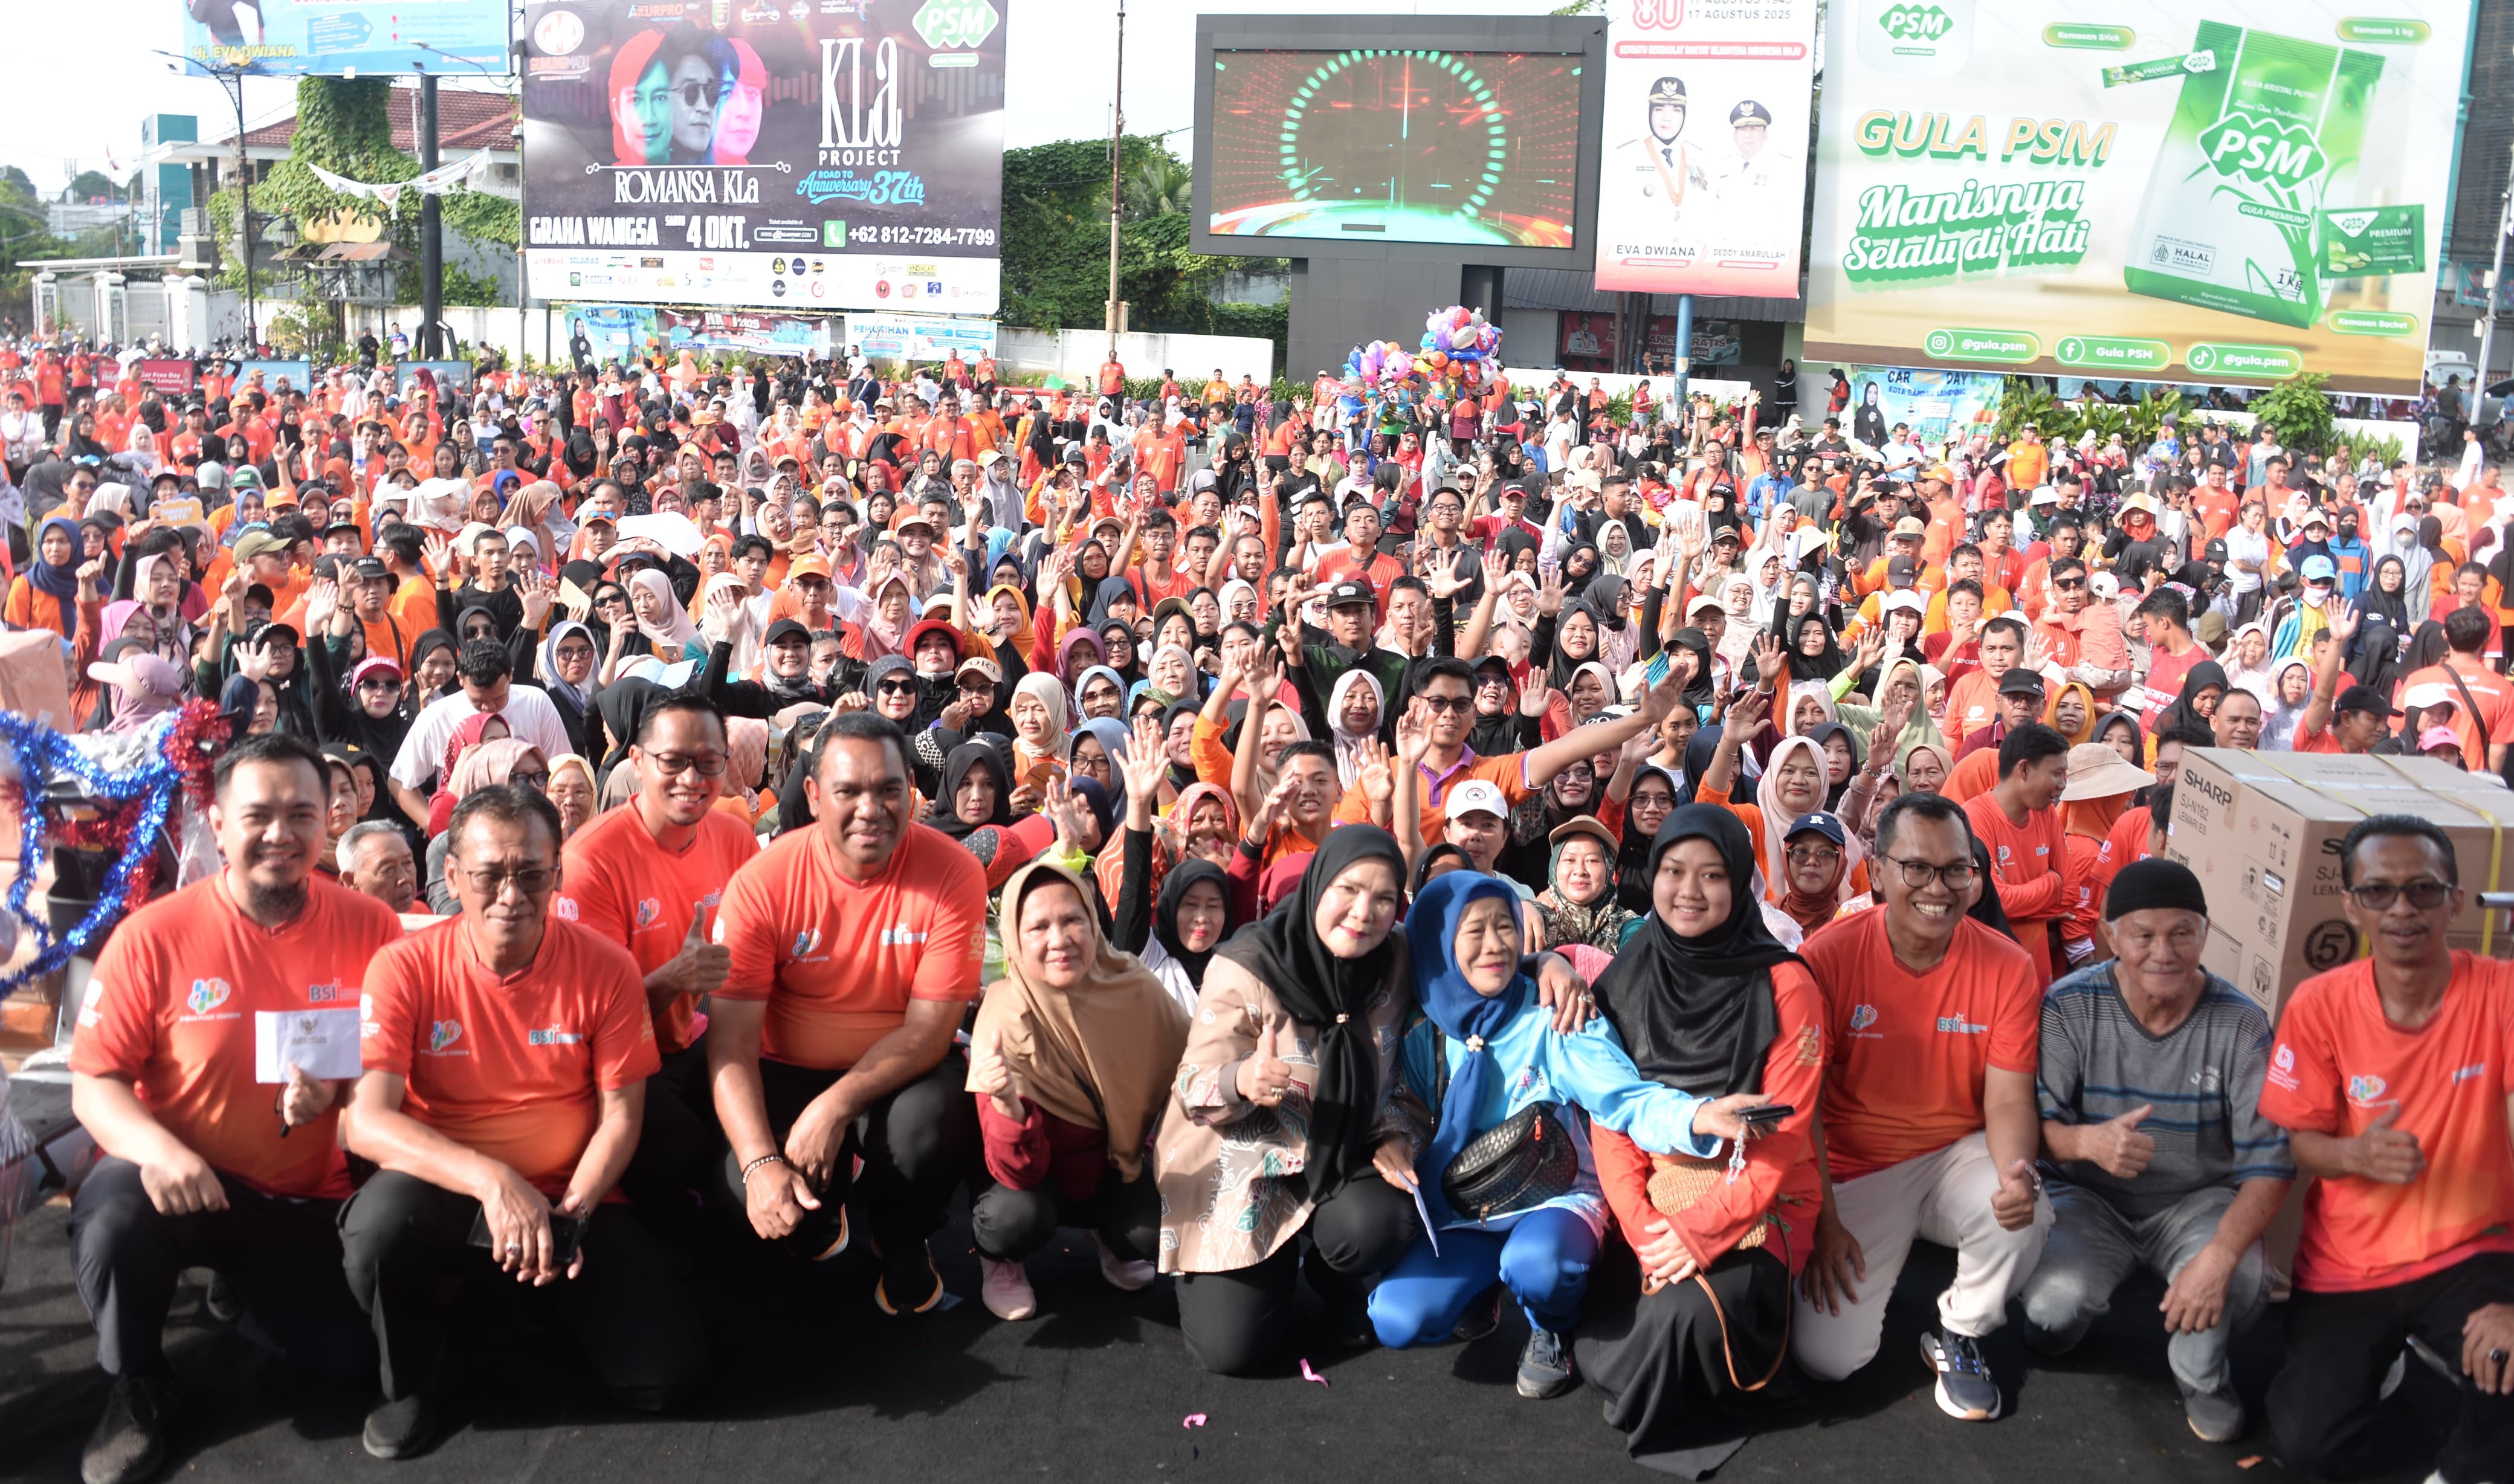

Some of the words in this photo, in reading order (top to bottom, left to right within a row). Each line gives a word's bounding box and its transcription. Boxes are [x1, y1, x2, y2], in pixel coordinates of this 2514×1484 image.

[925, 7, 987, 36] PSM
[1688, 10, 1701, 19] 17
[1704, 10, 1759, 20] AGUSTUS
[1764, 10, 1791, 19] 2025
[1887, 11, 1945, 34] PSM
[2057, 31, 2097, 40] Kemasan
[2098, 33, 2121, 42] Stick
[1855, 109, 1989, 162] GULA
[2001, 117, 2118, 168] PSM
[819, 149, 900, 167] PROJECT
[2212, 129, 2313, 178] PSM
[818, 170, 840, 179] ROAD
[841, 170, 854, 179] TO
[614, 170, 718, 204] ROMANSA
[869, 170, 925, 205] 37th
[1857, 179, 2084, 234] Manisnya
[2241, 204, 2264, 216] GULA
[529, 216, 586, 245] GRAHA
[587, 216, 659, 245] WANGSA
[686, 215, 702, 248] 4
[705, 215, 751, 249] OKT.
[848, 226, 877, 244] +62
[881, 226, 996, 246] 812-7284-7799
[2369, 228, 2412, 237] PREMIUM
[1617, 245, 1640, 255] EVA
[1645, 245, 1696, 257] DWIANA
[1713, 248, 1737, 257] DEDDY
[1740, 249, 1785, 259] AMARULLAH
[2174, 247, 2210, 263] HALAL
[2277, 273, 2284, 285] 1
[2338, 317, 2377, 328] Kemasan
[2379, 320, 2408, 329] Sachet
[1692, 338, 1727, 347] RATIS
[1962, 339, 2027, 352] @gula.psm
[2096, 347, 2124, 358] Gula
[2127, 349, 2153, 360] PSM
[2224, 353, 2289, 368] @gula.psm
[1887, 370, 1911, 384] CAR
[1947, 372, 1968, 385] DAY
[1888, 385, 1906, 395] KOTA
[1907, 387, 1935, 397] BANDAR
[1937, 388, 1966, 397] LAMPUNG
[2185, 769, 2232, 807] SHARP
[2180, 793, 2209, 822] SJ-N162
[1809, 816, 1824, 825] R
[2178, 809, 2197, 830] LEMARI
[2318, 935, 2345, 964] 5
[309, 984, 336, 1003] BSI
[1937, 1017, 1958, 1033] BSI
[529, 1030, 554, 1045] BSI
